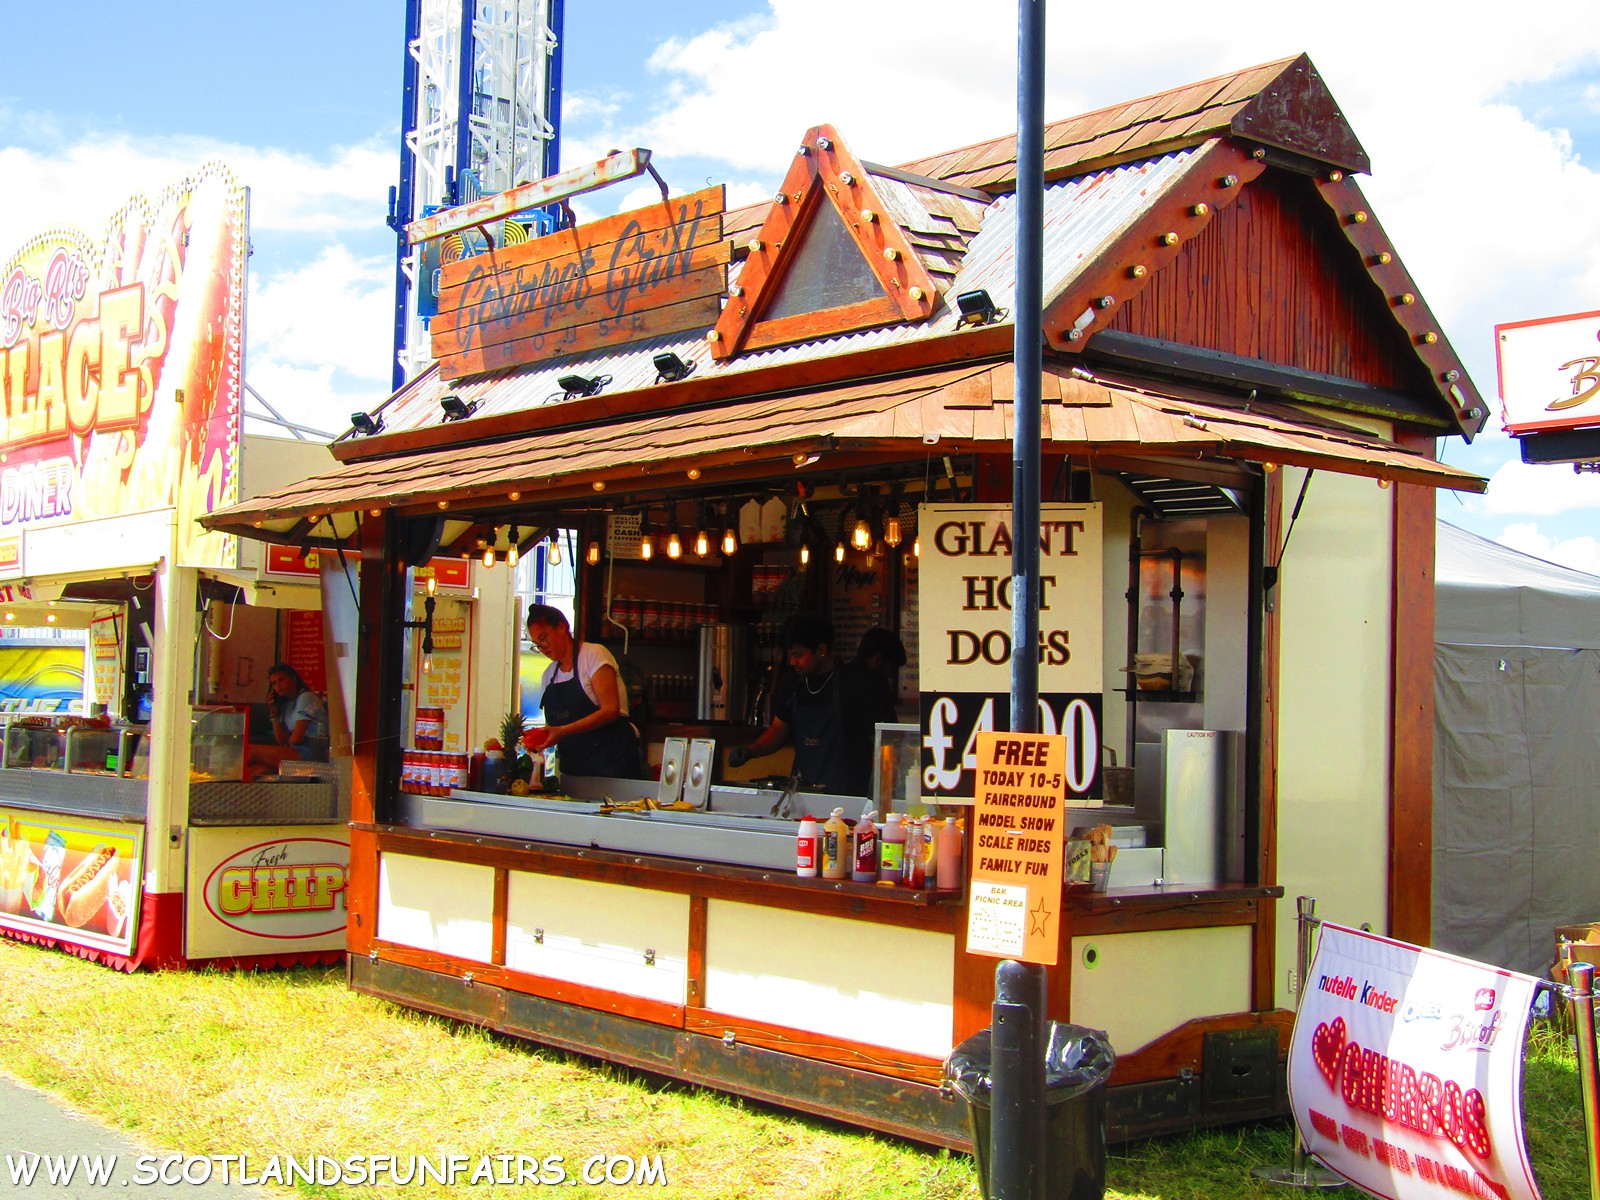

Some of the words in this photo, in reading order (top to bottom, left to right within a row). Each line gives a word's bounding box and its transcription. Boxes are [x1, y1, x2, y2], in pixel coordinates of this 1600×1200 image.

[456, 246, 594, 358] Gourmet
[607, 199, 704, 324] Grill
[488, 260, 513, 278] THE
[1, 264, 41, 348] Big
[44, 246, 90, 332] Al's
[502, 313, 643, 358] HOUSE
[0, 281, 144, 453] LACE
[1, 455, 73, 526] DINER
[946, 629, 1072, 666] DOS
[993, 740, 1050, 767] FREE
[983, 770, 1025, 787] TODAY
[1030, 772, 1061, 789] 10-5
[984, 792, 1057, 809] FAIRGROUND
[979, 813, 1017, 829] MODEL
[1020, 815, 1055, 832] SHOW
[250, 844, 289, 871] Fresh
[979, 834, 1013, 850] SCALE
[1017, 838, 1051, 854] RIDES
[1068, 848, 1089, 867] FORKS
[980, 857, 1022, 874] FAMILY
[1025, 860, 1049, 877] FUN
[219, 862, 347, 916] CHIP
[975, 895, 1001, 906] PICNIC
[1002, 898, 1024, 908] AREA
[991, 887, 1007, 896] BAR
[1319, 974, 1358, 1001] nutella
[1360, 980, 1398, 1014] Kinder
[1440, 1009, 1508, 1052] Biscoff
[1415, 1154, 1434, 1181] HOT
